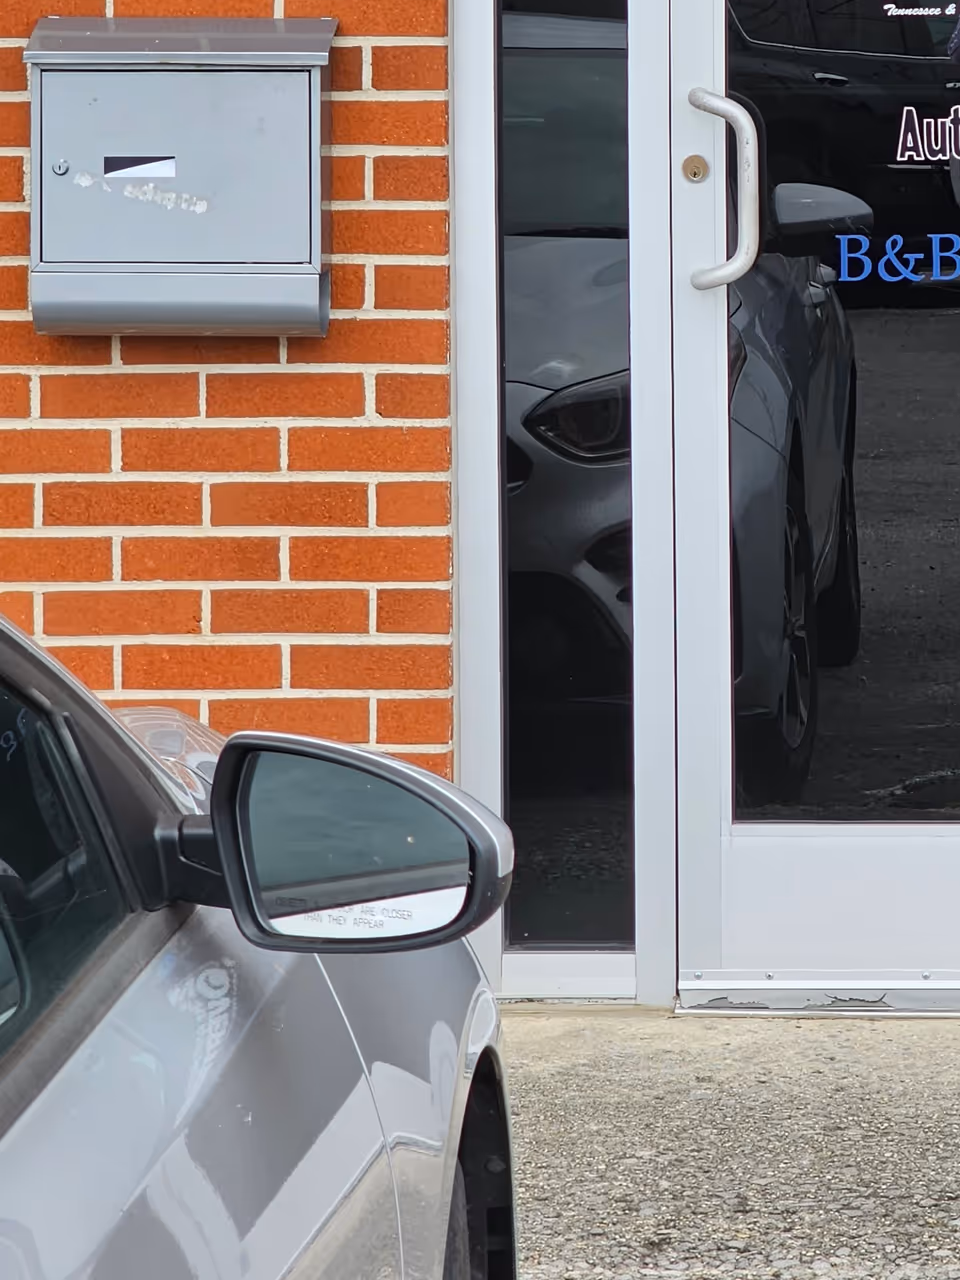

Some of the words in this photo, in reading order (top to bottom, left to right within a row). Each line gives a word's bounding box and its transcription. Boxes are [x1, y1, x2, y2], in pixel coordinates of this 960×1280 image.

[883, 4, 942, 17] Tennessee
[945, 3, 956, 15] &
[382, 907, 413, 920] CLOSER
[353, 917, 385, 929] APPEAR
